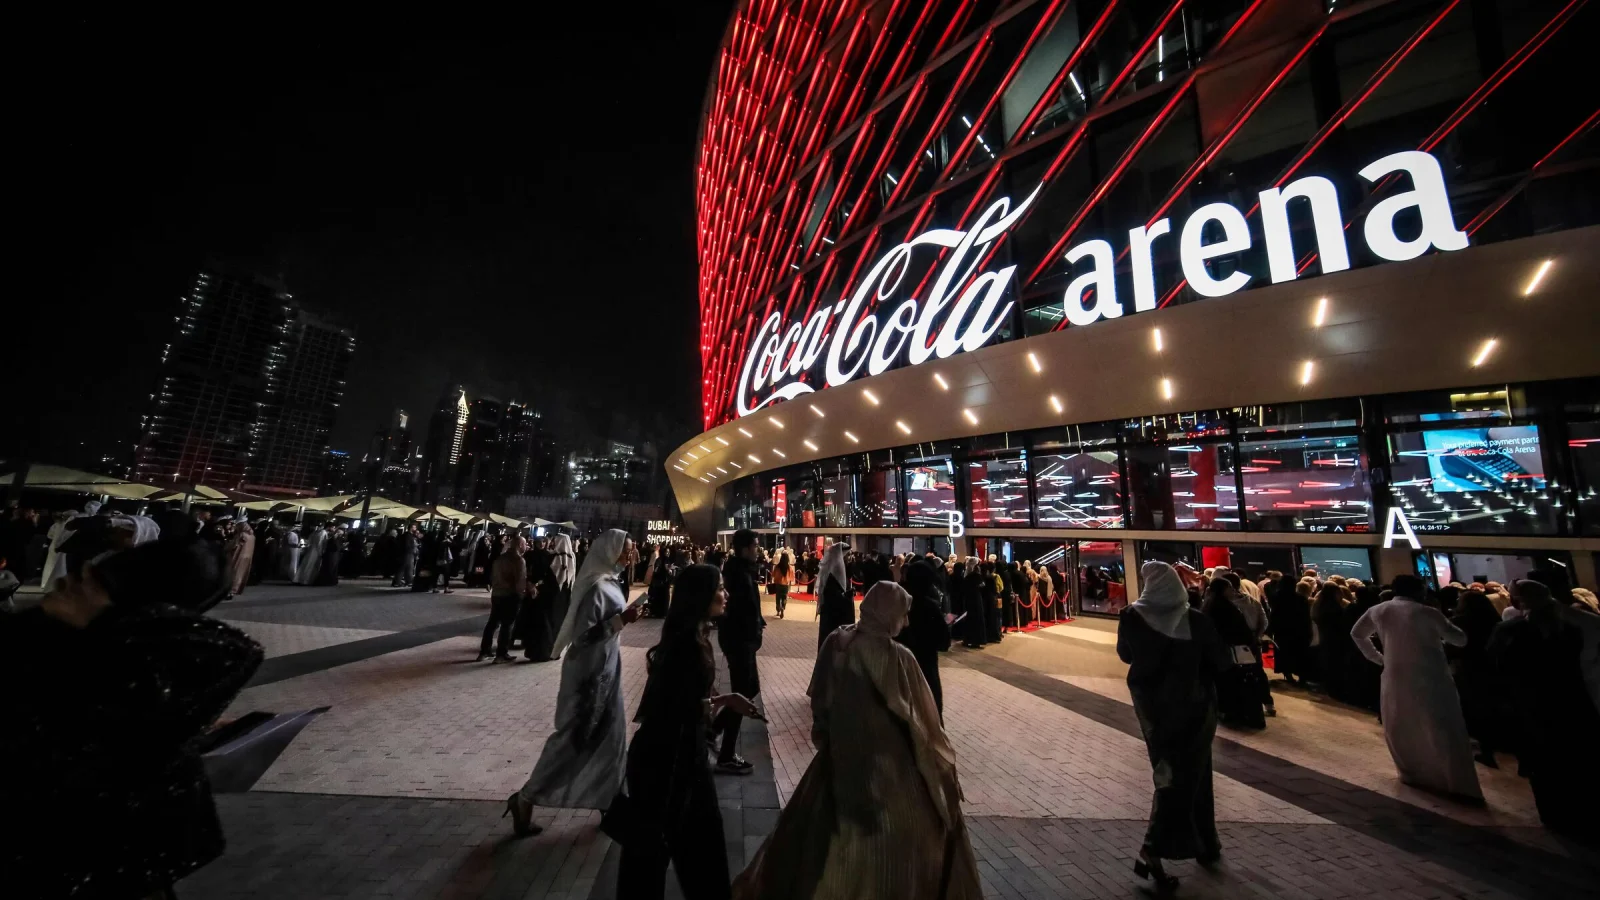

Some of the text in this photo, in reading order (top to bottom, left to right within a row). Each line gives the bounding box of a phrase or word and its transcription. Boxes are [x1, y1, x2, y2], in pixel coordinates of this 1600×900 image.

[737, 151, 1470, 417] Coca-Cola arena
[1489, 437, 1520, 448] payment
[1479, 446, 1514, 456] Coca-Cola
[647, 520, 671, 531] DUBAI
[779, 516, 786, 534] C
[949, 510, 964, 537] B
[1384, 507, 1422, 549] A
[646, 534, 685, 546] SHOPPING
